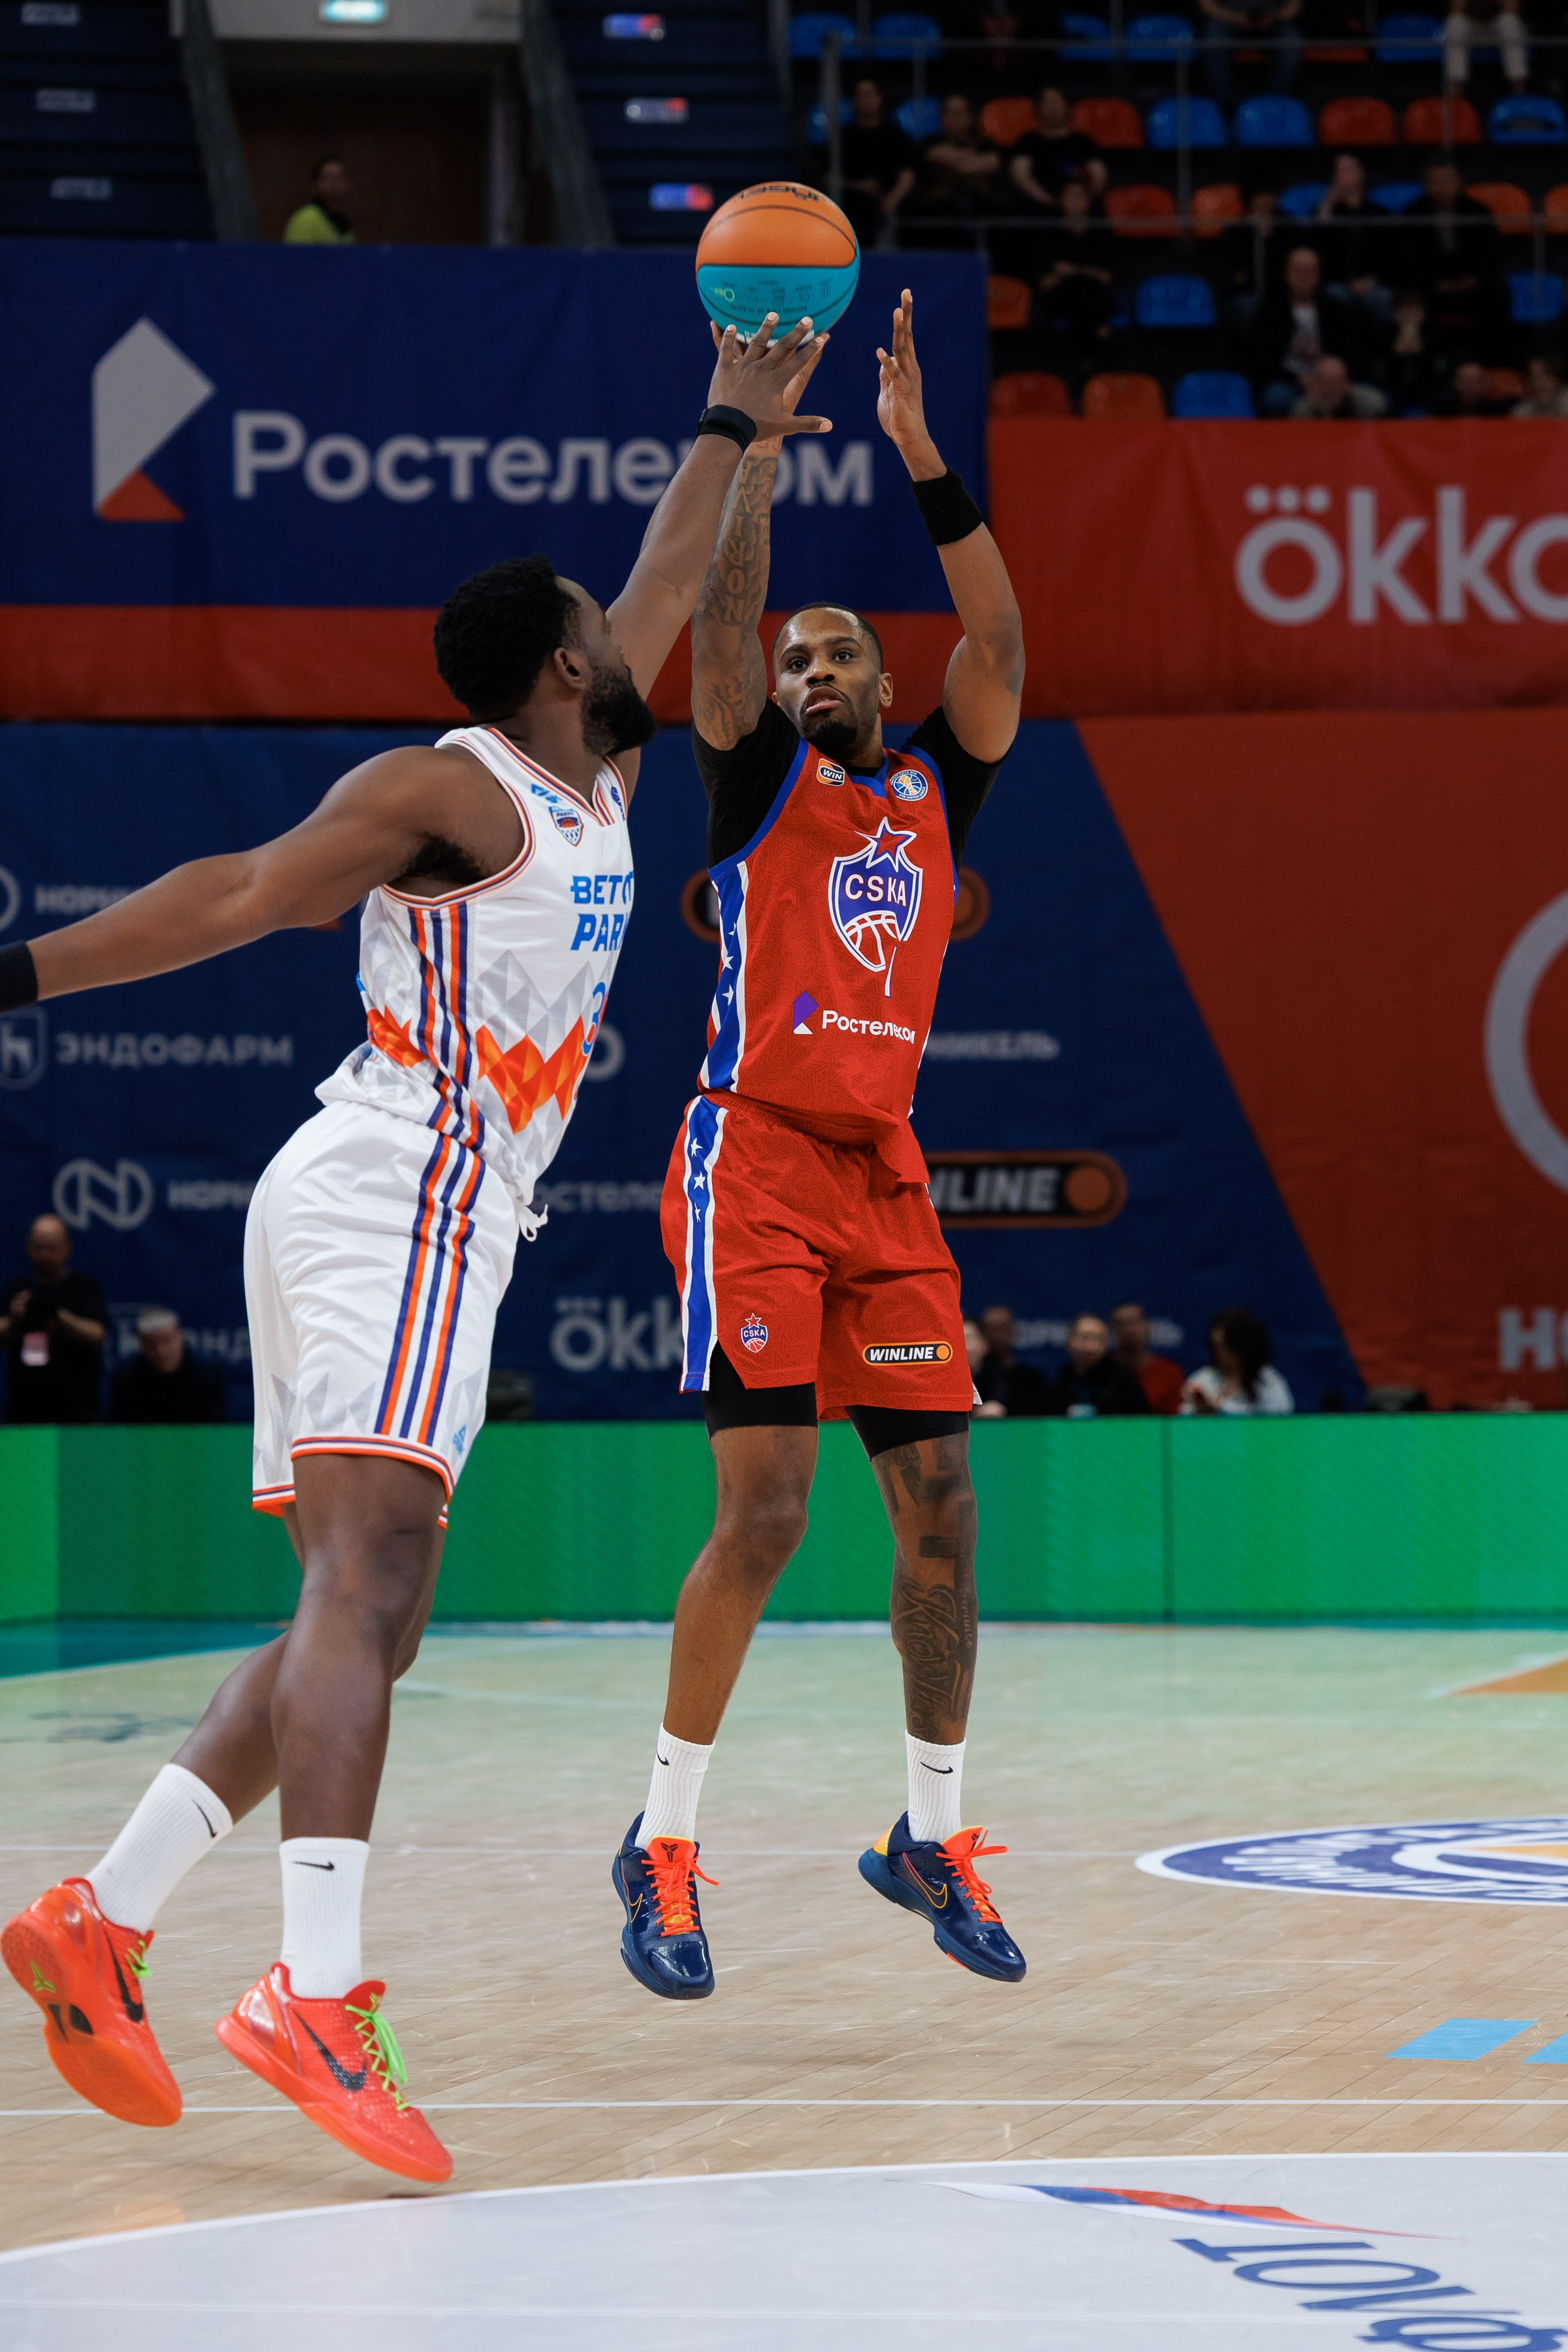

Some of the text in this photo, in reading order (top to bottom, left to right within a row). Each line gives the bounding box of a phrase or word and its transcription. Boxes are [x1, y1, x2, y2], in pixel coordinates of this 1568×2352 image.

[233, 410, 872, 505] Ростелем
[823, 768, 842, 780] WIN
[845, 873, 907, 907] CSKA
[56, 1032, 293, 1068] ЭНДОФАРМ
[549, 1296, 684, 1373] ökk
[743, 1329, 766, 1337] CSKA
[870, 1347, 934, 1361] WINLINE
[1170, 2238, 1568, 2352] ФЛОТ
